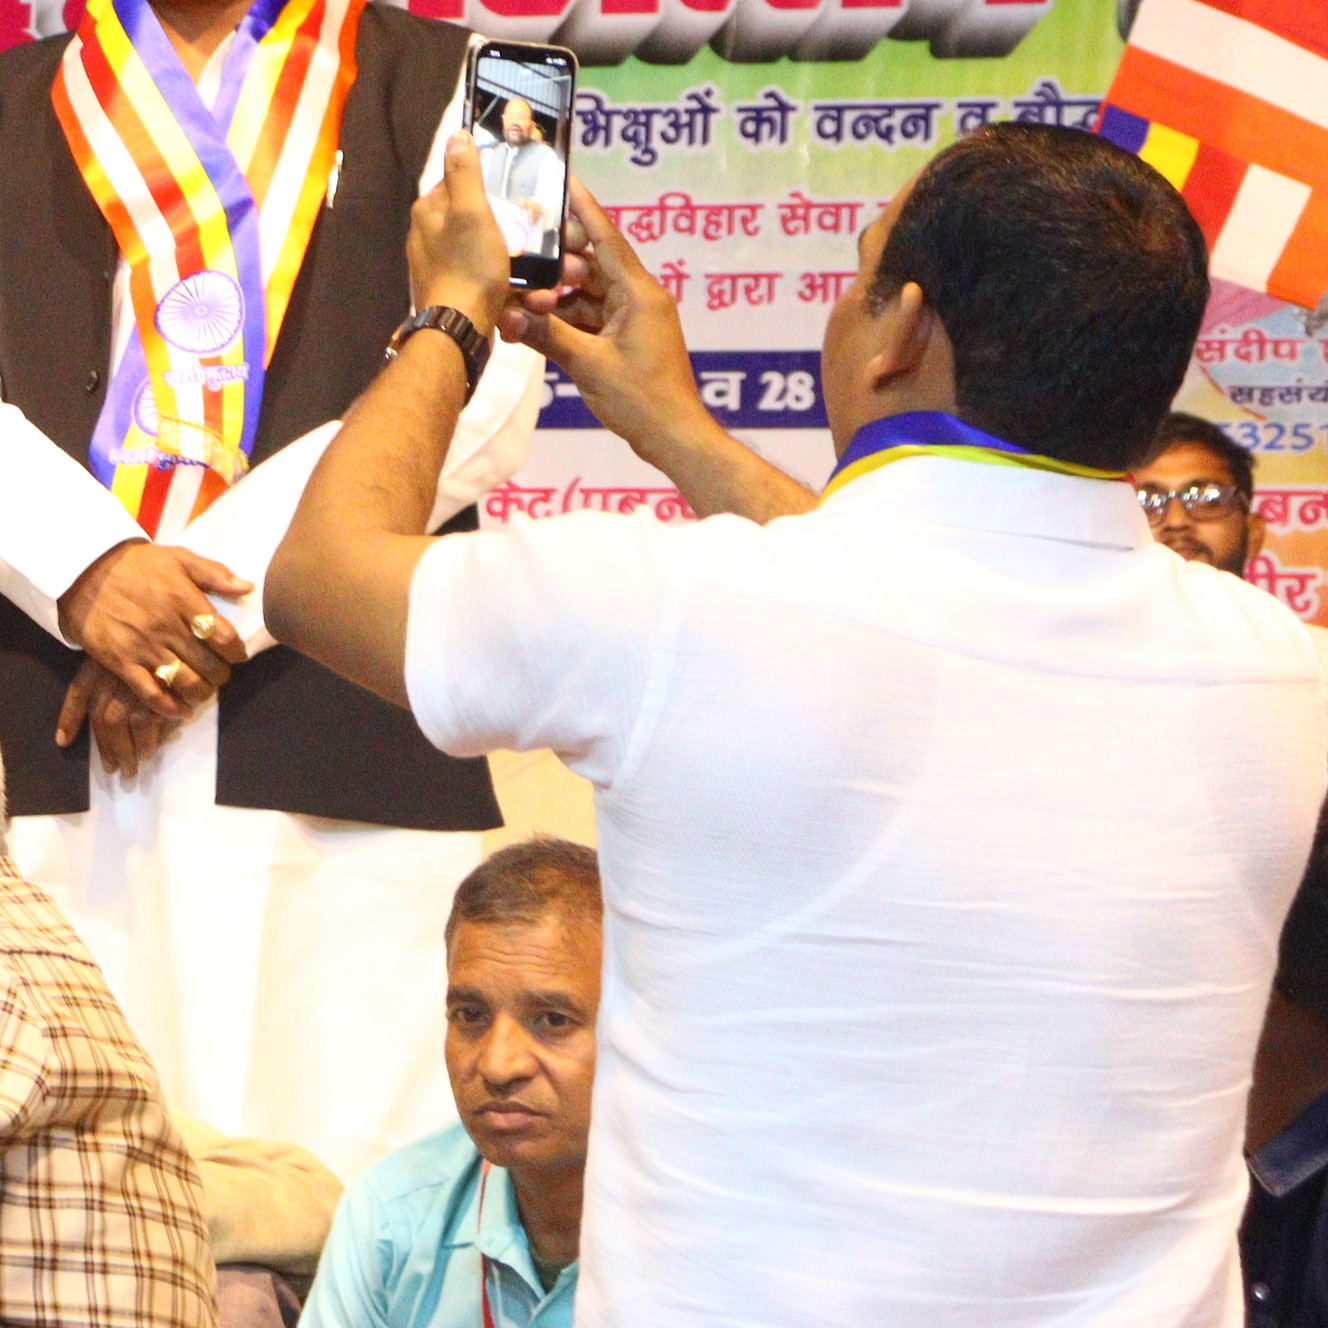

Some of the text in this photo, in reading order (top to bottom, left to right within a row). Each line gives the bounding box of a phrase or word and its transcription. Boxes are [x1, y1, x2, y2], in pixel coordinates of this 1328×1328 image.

[737, 90, 798, 144] को
[814, 101, 942, 144] वन्दन
[778, 191, 865, 236] सेवा
[705, 272, 783, 311] द्वारा
[1196, 328, 1305, 363] संदीप
[700, 370, 816, 411] व 28
[1228, 378, 1328, 406] सहसंय
